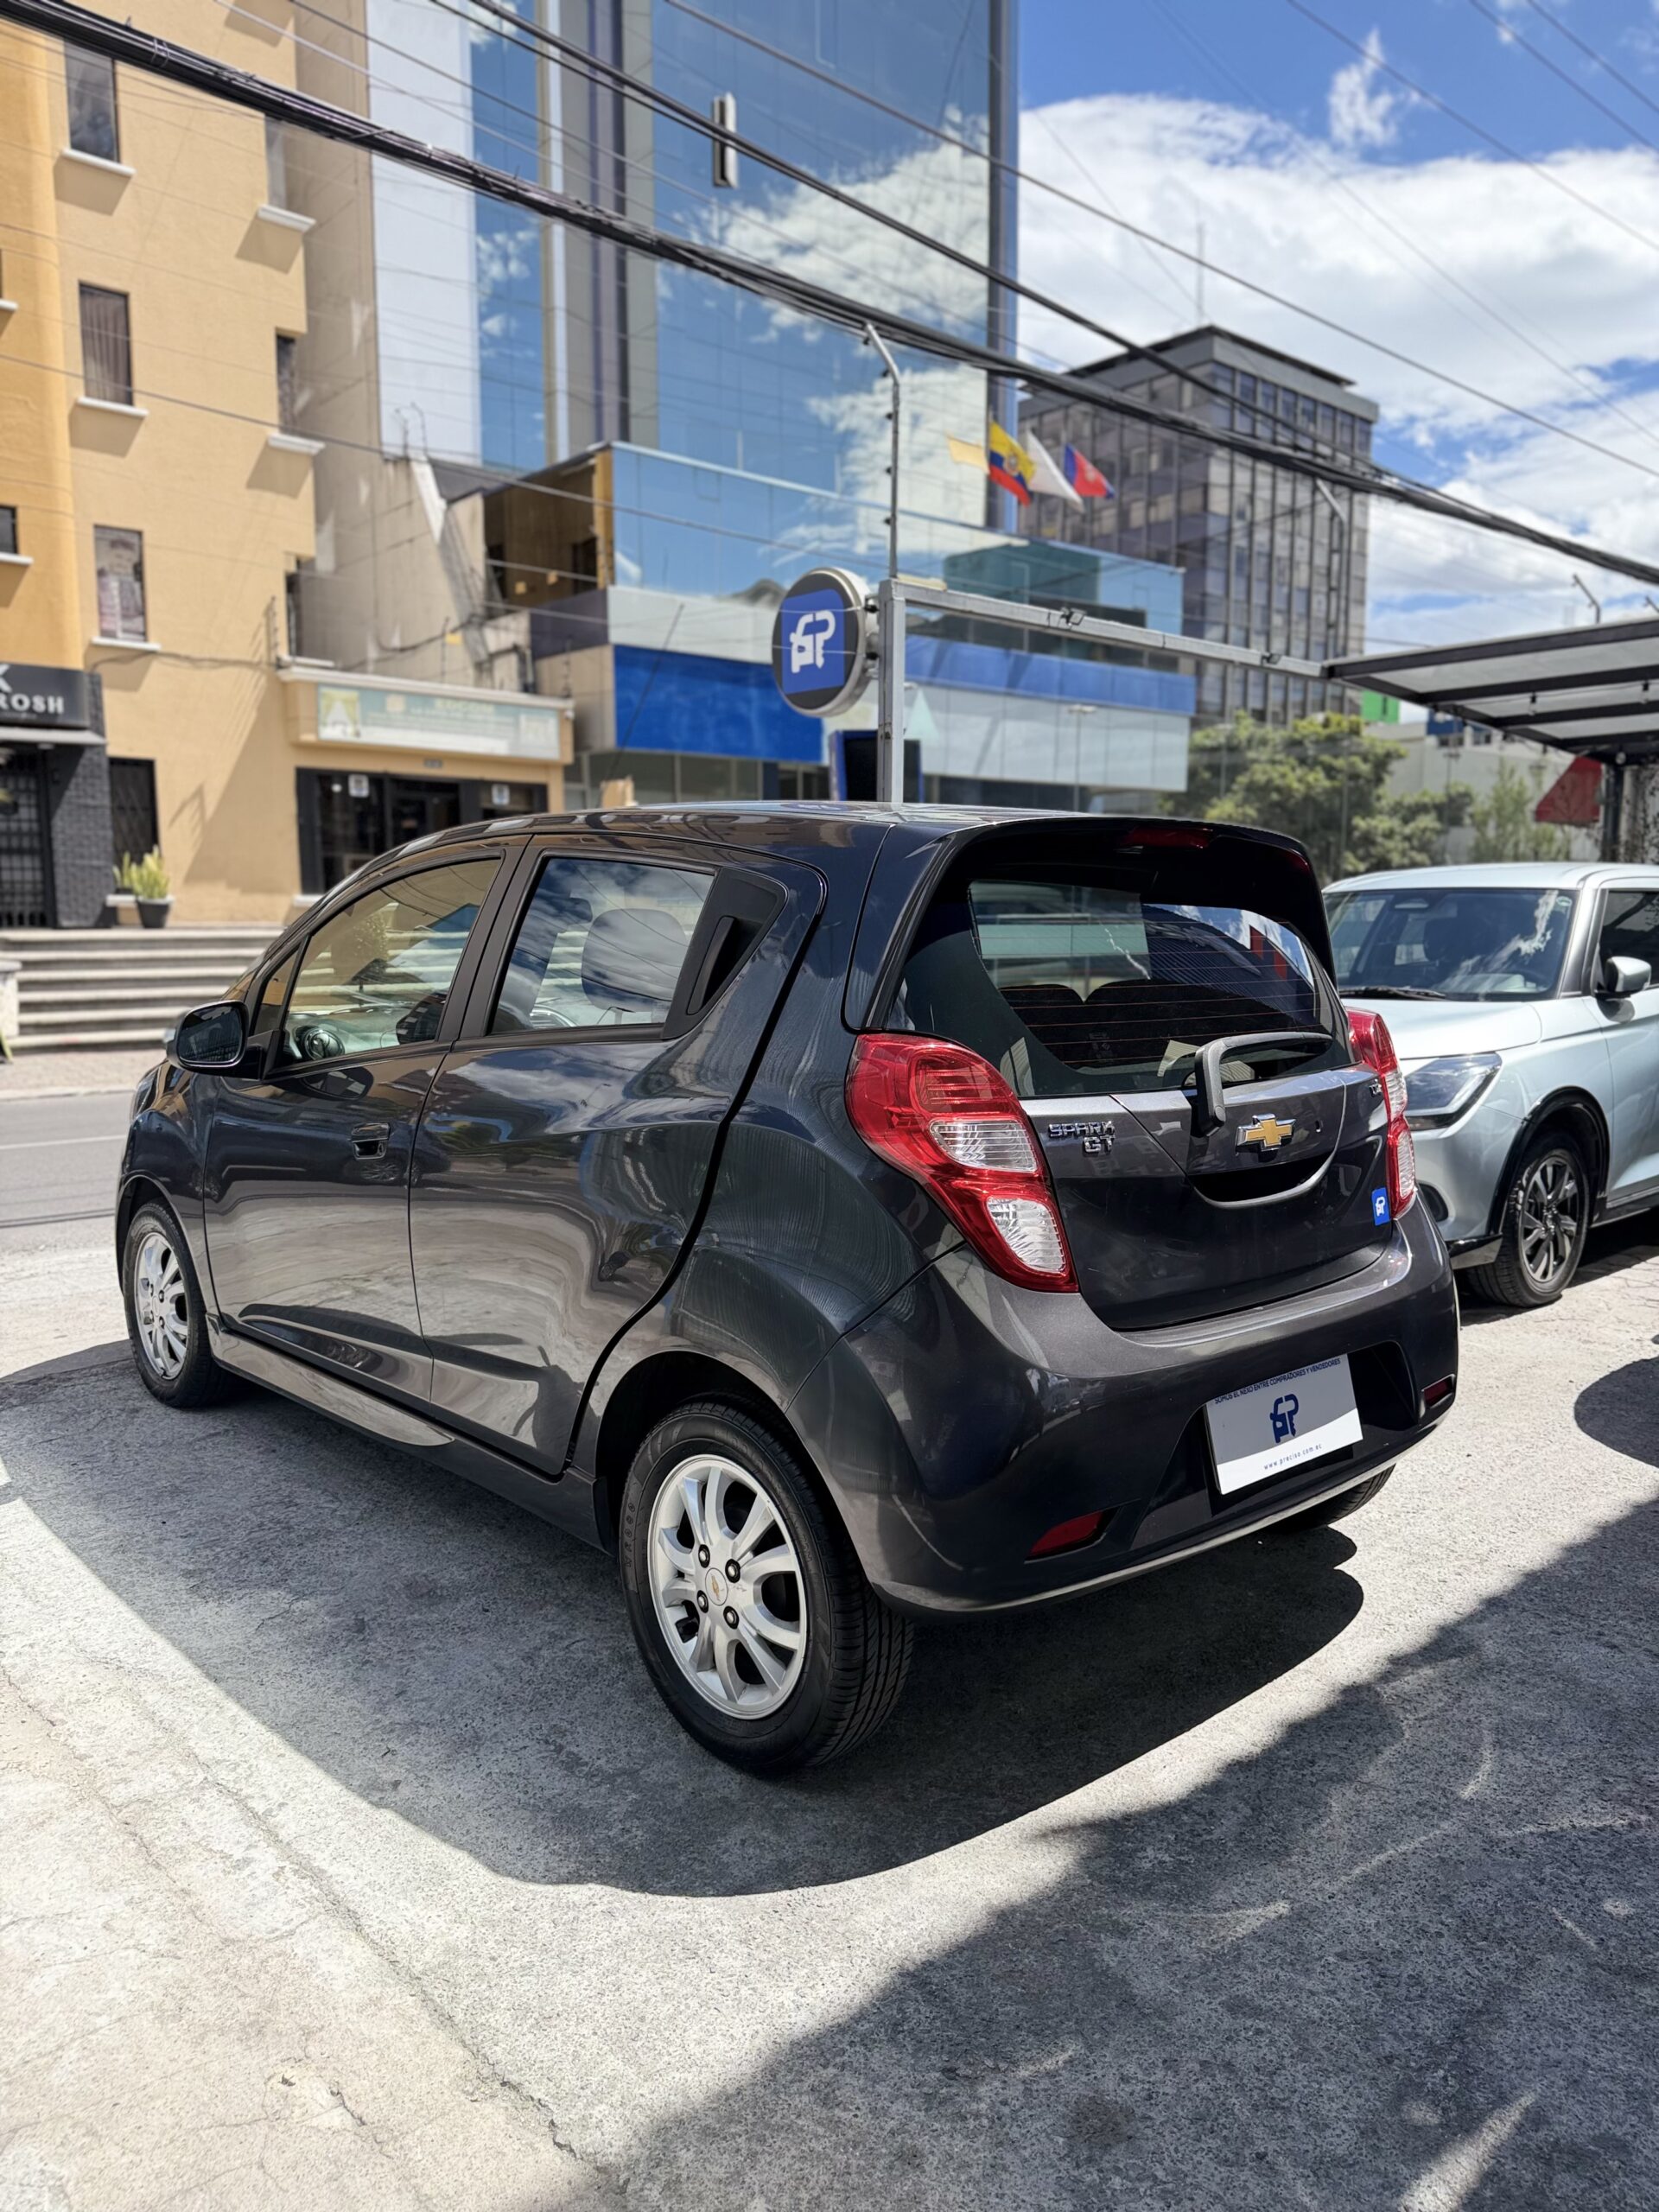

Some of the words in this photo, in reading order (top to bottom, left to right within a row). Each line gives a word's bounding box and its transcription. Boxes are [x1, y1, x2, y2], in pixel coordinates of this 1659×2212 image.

[1048, 1121, 1116, 1137] SPARK
[1084, 1135, 1116, 1153] GT
[1240, 1384, 1254, 1395] NEXO
[1254, 1380, 1270, 1391] ENTRE
[1269, 1368, 1306, 1386] COMPRADORES
[1310, 1357, 1341, 1373] VENDEDORES
[1264, 1444, 1322, 1469] wwwprecisocomec
